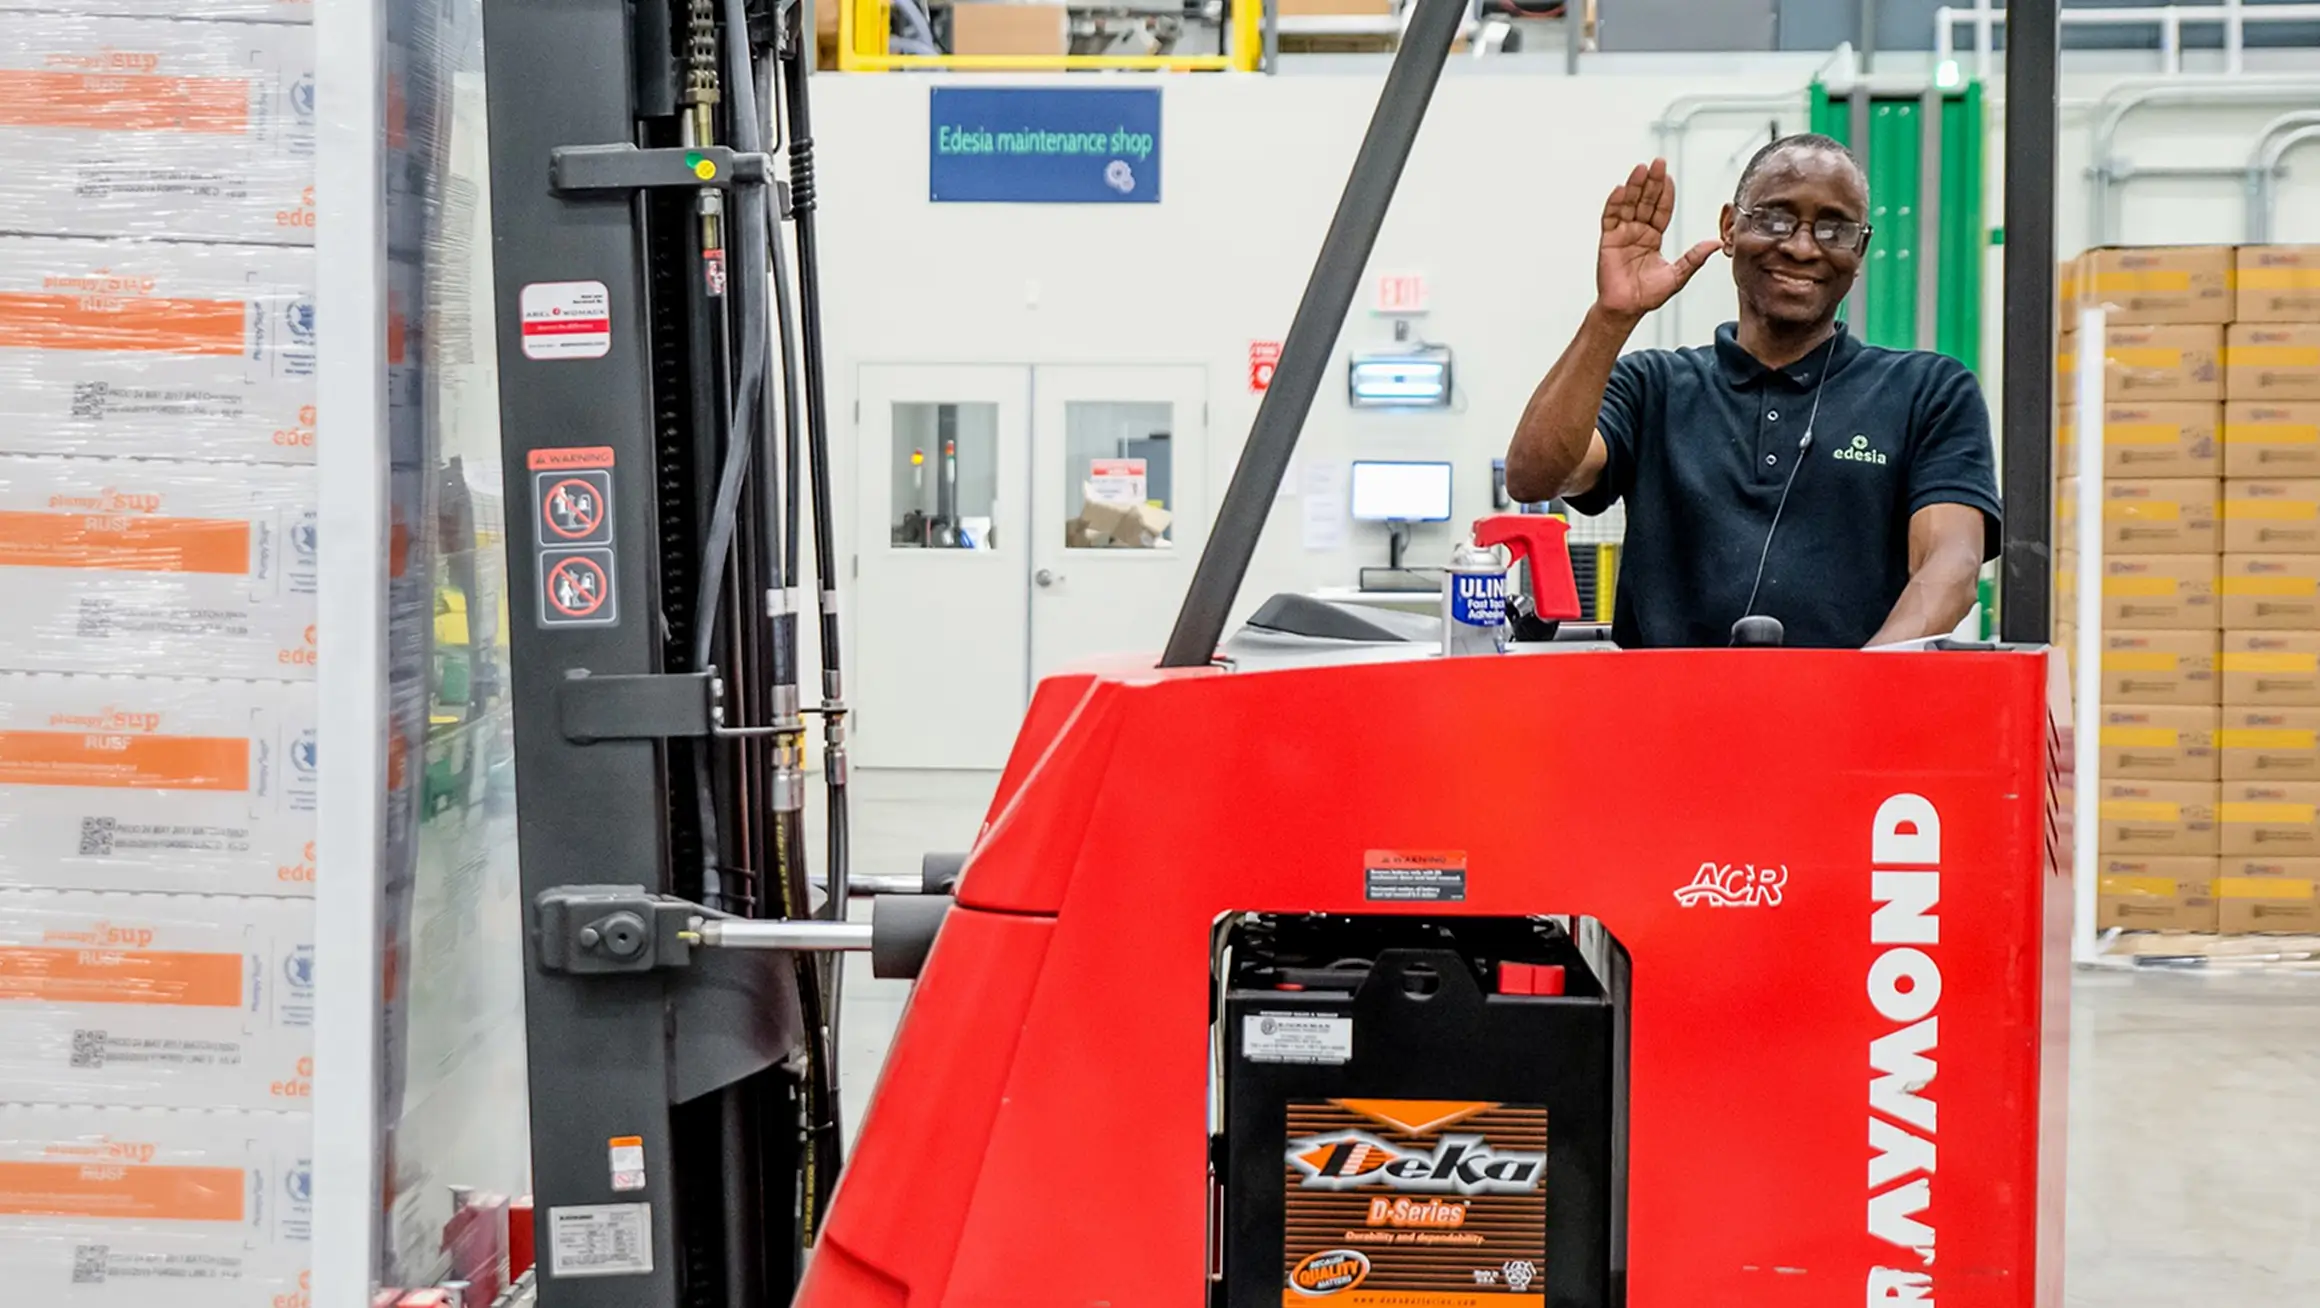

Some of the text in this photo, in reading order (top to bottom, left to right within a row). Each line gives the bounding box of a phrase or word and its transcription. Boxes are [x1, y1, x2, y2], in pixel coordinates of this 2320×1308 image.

[939, 125, 1153, 160] Edesia maintenance shop
[550, 452, 609, 464] WARNING
[1833, 446, 1886, 464] edesia
[1460, 578, 1504, 598] ULIN
[113, 711, 160, 732] sup
[85, 735, 131, 750] RUSF
[1673, 862, 1788, 907] ACR
[107, 926, 154, 947] sup
[1297, 1138, 1538, 1185] Deka
[1370, 1199, 1464, 1223] D-Series
[1345, 1231, 1395, 1245] Durability
[1395, 1232, 1417, 1243] and
[1300, 1260, 1360, 1287] QUALITY
